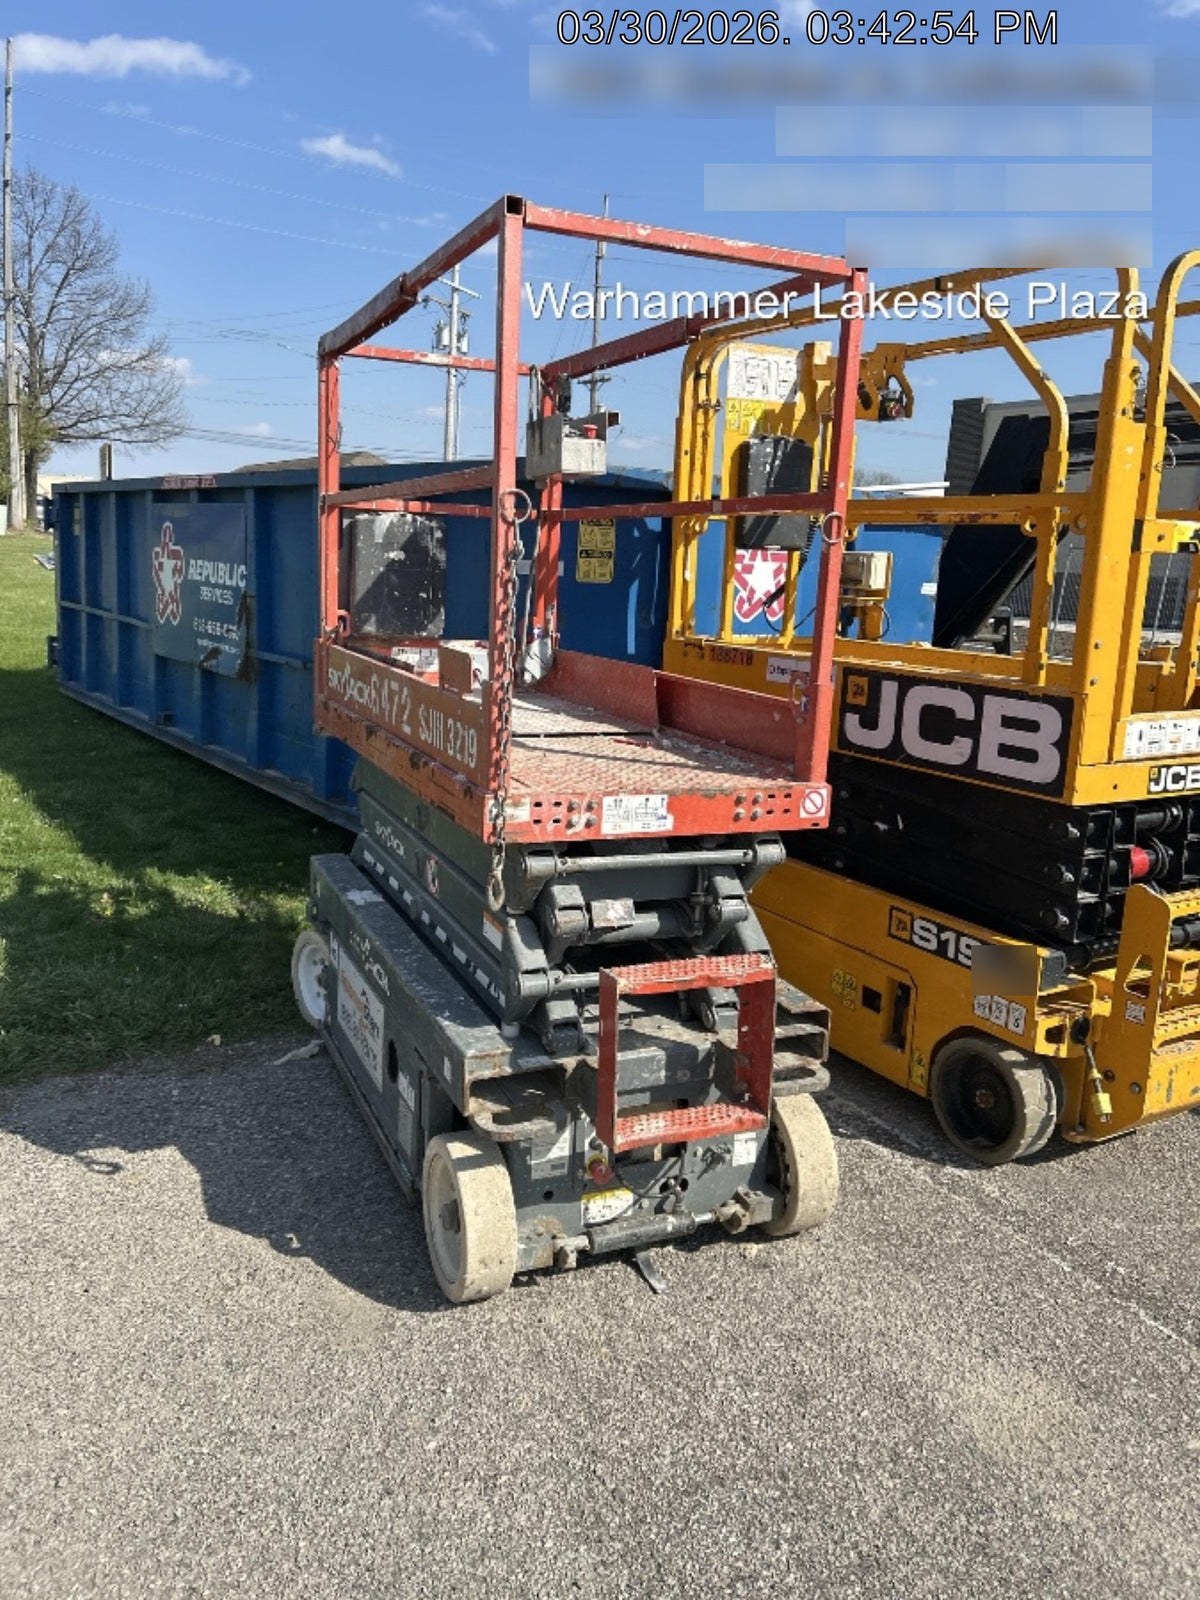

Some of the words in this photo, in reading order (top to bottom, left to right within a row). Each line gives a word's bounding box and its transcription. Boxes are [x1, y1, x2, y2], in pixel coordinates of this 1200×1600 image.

[188, 559, 247, 587] REPUBLIC
[200, 586, 234, 606] SERVICES
[370, 672, 412, 736] 6472
[447, 717, 478, 769] 3219
[844, 680, 1063, 784] JCB
[1149, 765, 1200, 792] JCB
